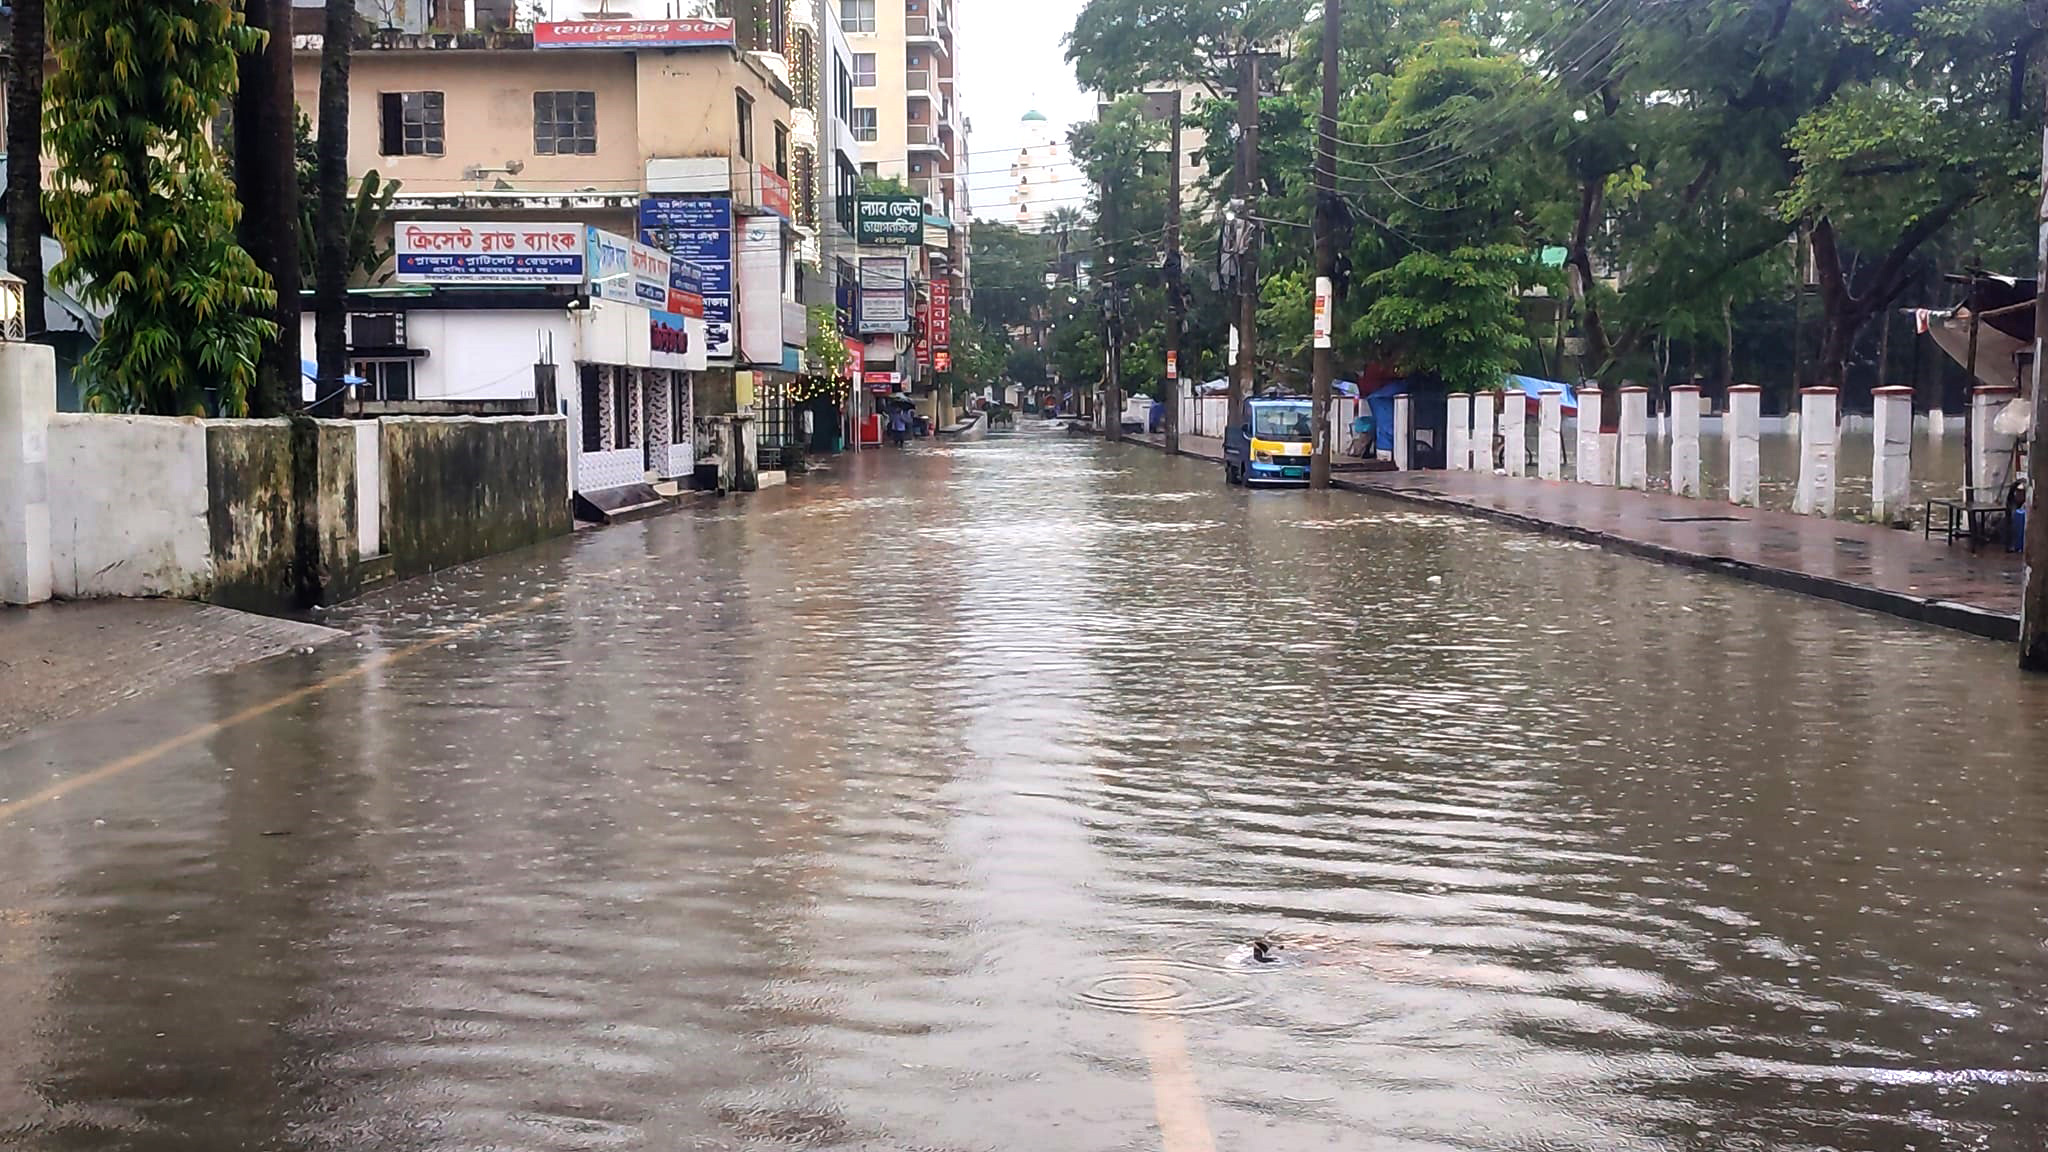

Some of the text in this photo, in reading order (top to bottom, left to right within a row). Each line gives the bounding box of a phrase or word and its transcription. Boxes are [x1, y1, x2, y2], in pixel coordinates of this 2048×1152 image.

[553, 23, 622, 36] হোটেল
[627, 23, 670, 34] স্টার
[860, 197, 921, 217] ল্যাব ডেল্টা
[863, 217, 919, 234] ডায়াগনস্টিক
[405, 225, 577, 253] ক্রিসেন্ট ব্লাড ব্যাংক
[465, 255, 515, 267] প্লাটিলেট
[524, 256, 574, 267] রেডসেল
